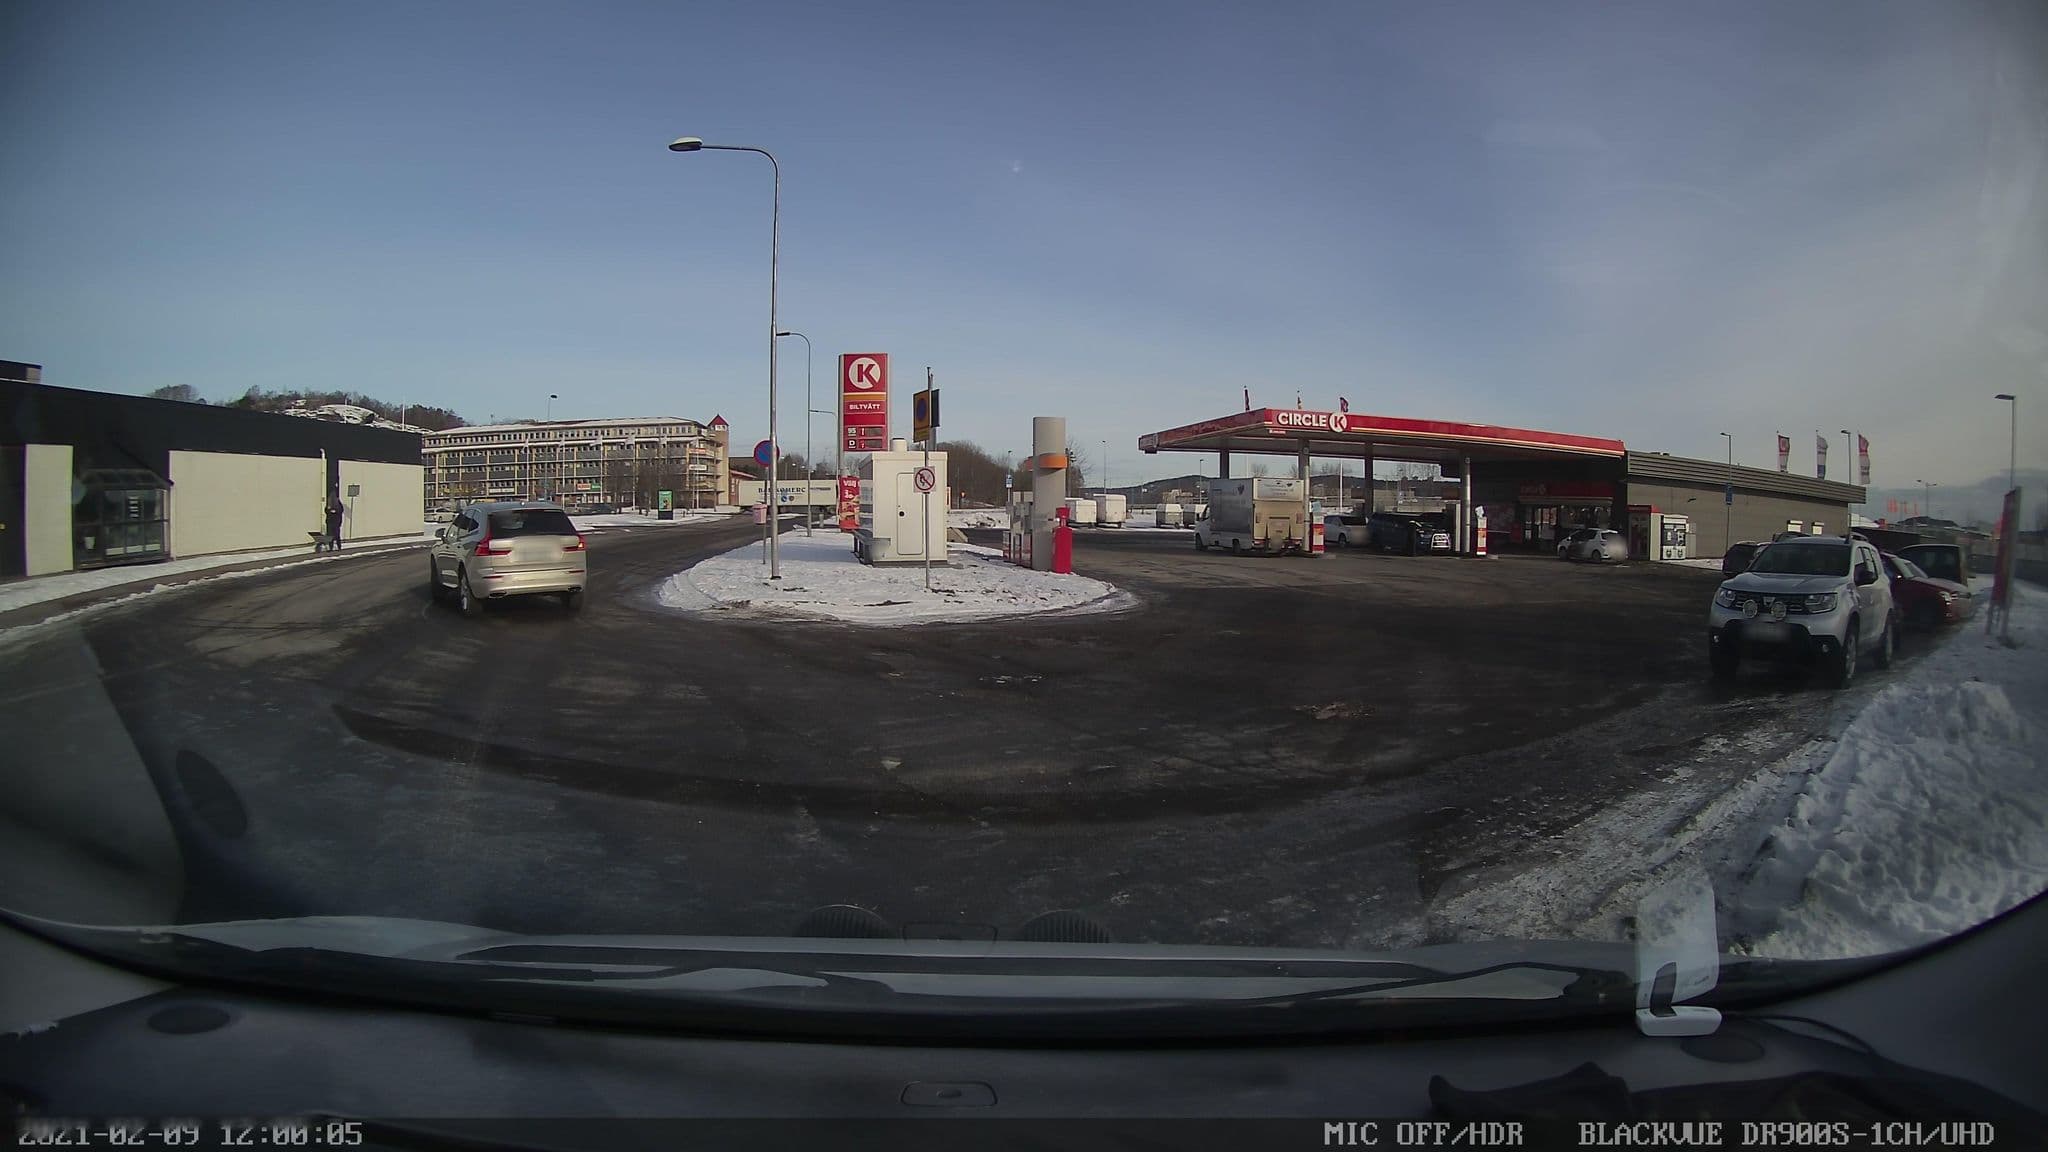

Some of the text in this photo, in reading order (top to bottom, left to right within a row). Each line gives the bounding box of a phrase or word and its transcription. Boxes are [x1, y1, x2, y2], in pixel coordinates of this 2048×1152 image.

[855, 363, 879, 388] K
[1278, 412, 1346, 431] CIRCLE K
